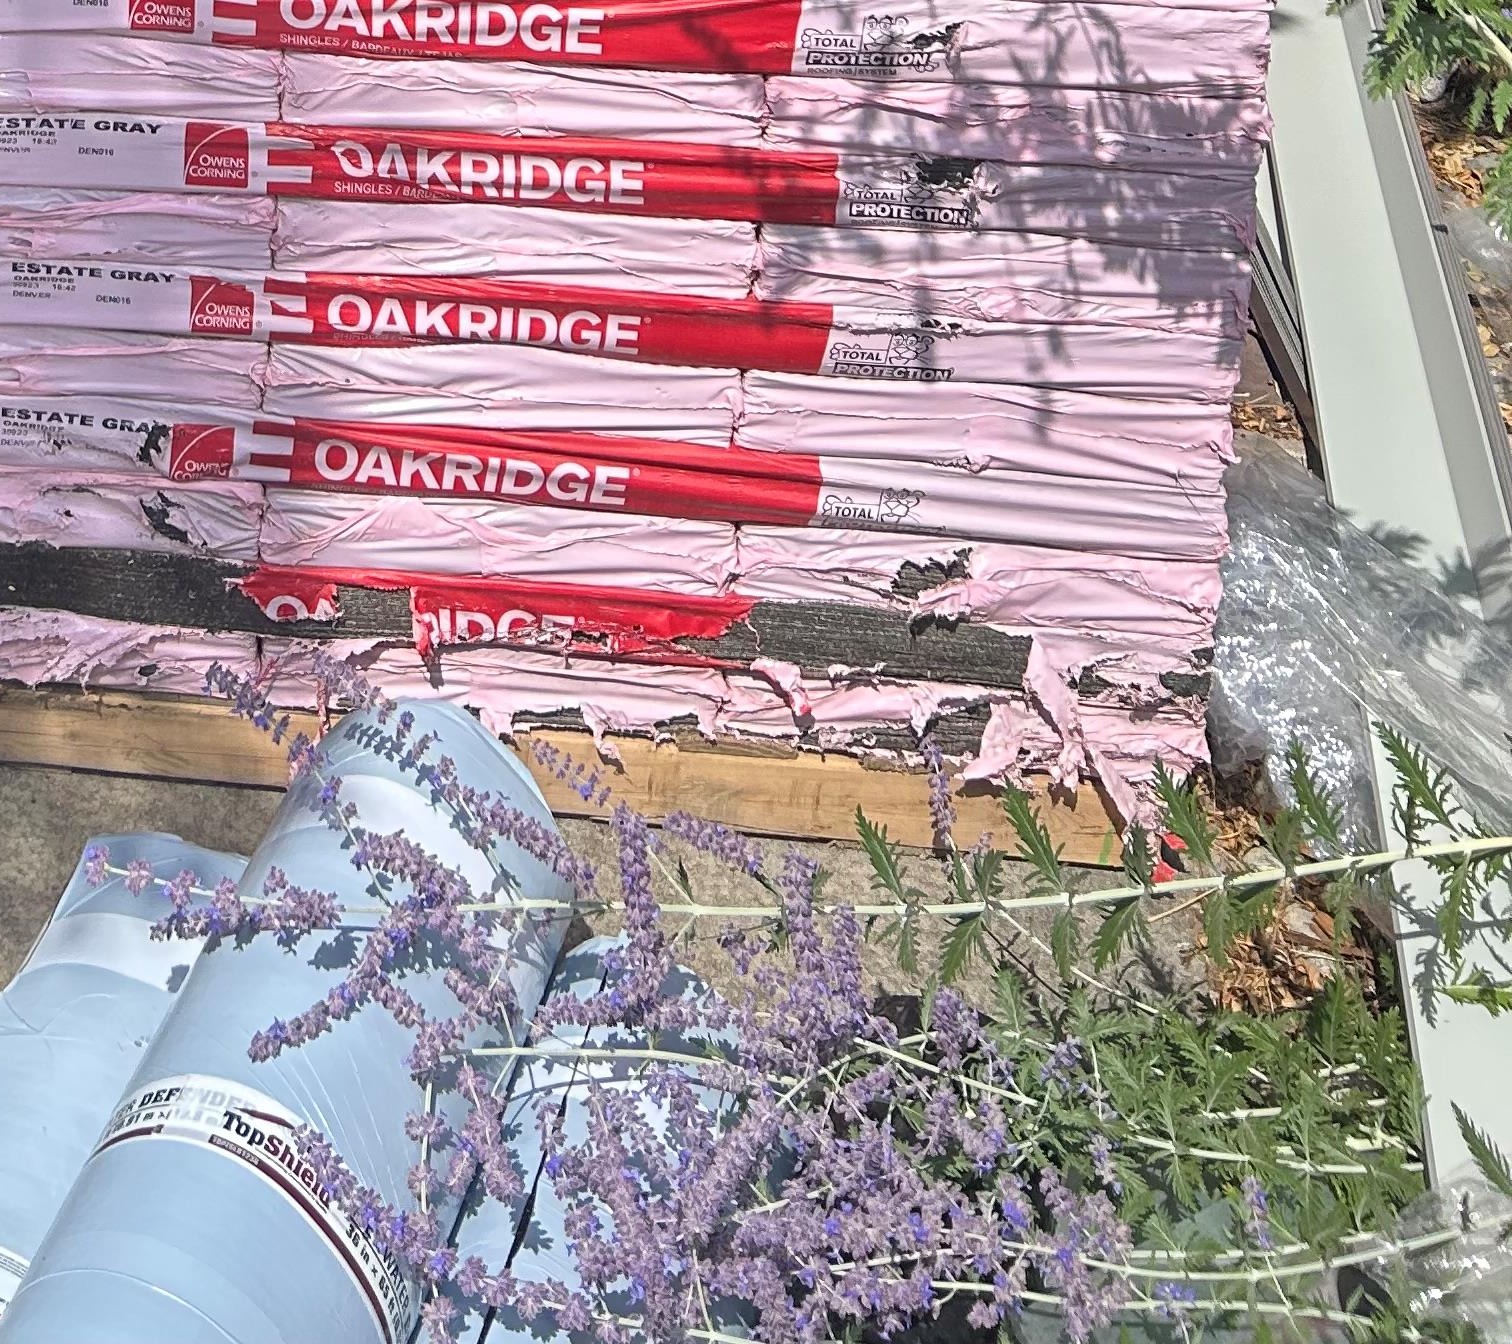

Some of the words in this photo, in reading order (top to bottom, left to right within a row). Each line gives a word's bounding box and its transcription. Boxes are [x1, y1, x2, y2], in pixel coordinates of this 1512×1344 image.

[144, 0, 192, 18] OWENS
[133, 11, 192, 29] CORNING
[279, 32, 341, 49] SHINGLES
[813, 36, 857, 49] TOTAL
[807, 52, 930, 67] PROTECTION
[93, 120, 163, 135] GRAY
[198, 154, 246, 169] OWENS
[188, 164, 246, 180] CORNING
[330, 139, 646, 206] OAKRIDGE
[333, 180, 393, 196] SHINGLES
[856, 190, 897, 202] TOTAL
[850, 202, 969, 225] PROTECTION
[11, 261, 103, 279] ESTATE
[110, 269, 176, 284] GRAY
[205, 301, 251, 318] OWENS
[193, 314, 251, 330] CORNING
[327, 293, 643, 356] OAKRIDGE
[841, 350, 883, 362] TOTAL
[834, 364, 950, 381] PROTECTION
[0, 406, 95, 427] ESTATE
[101, 417, 158, 434] GRA
[315, 438, 630, 507] OAKRIDGE
[834, 505, 875, 520] TOTAL
[345, 1223, 361, 1248] 36
[360, 1243, 370, 1265] in
[378, 1275, 390, 1300] 65
